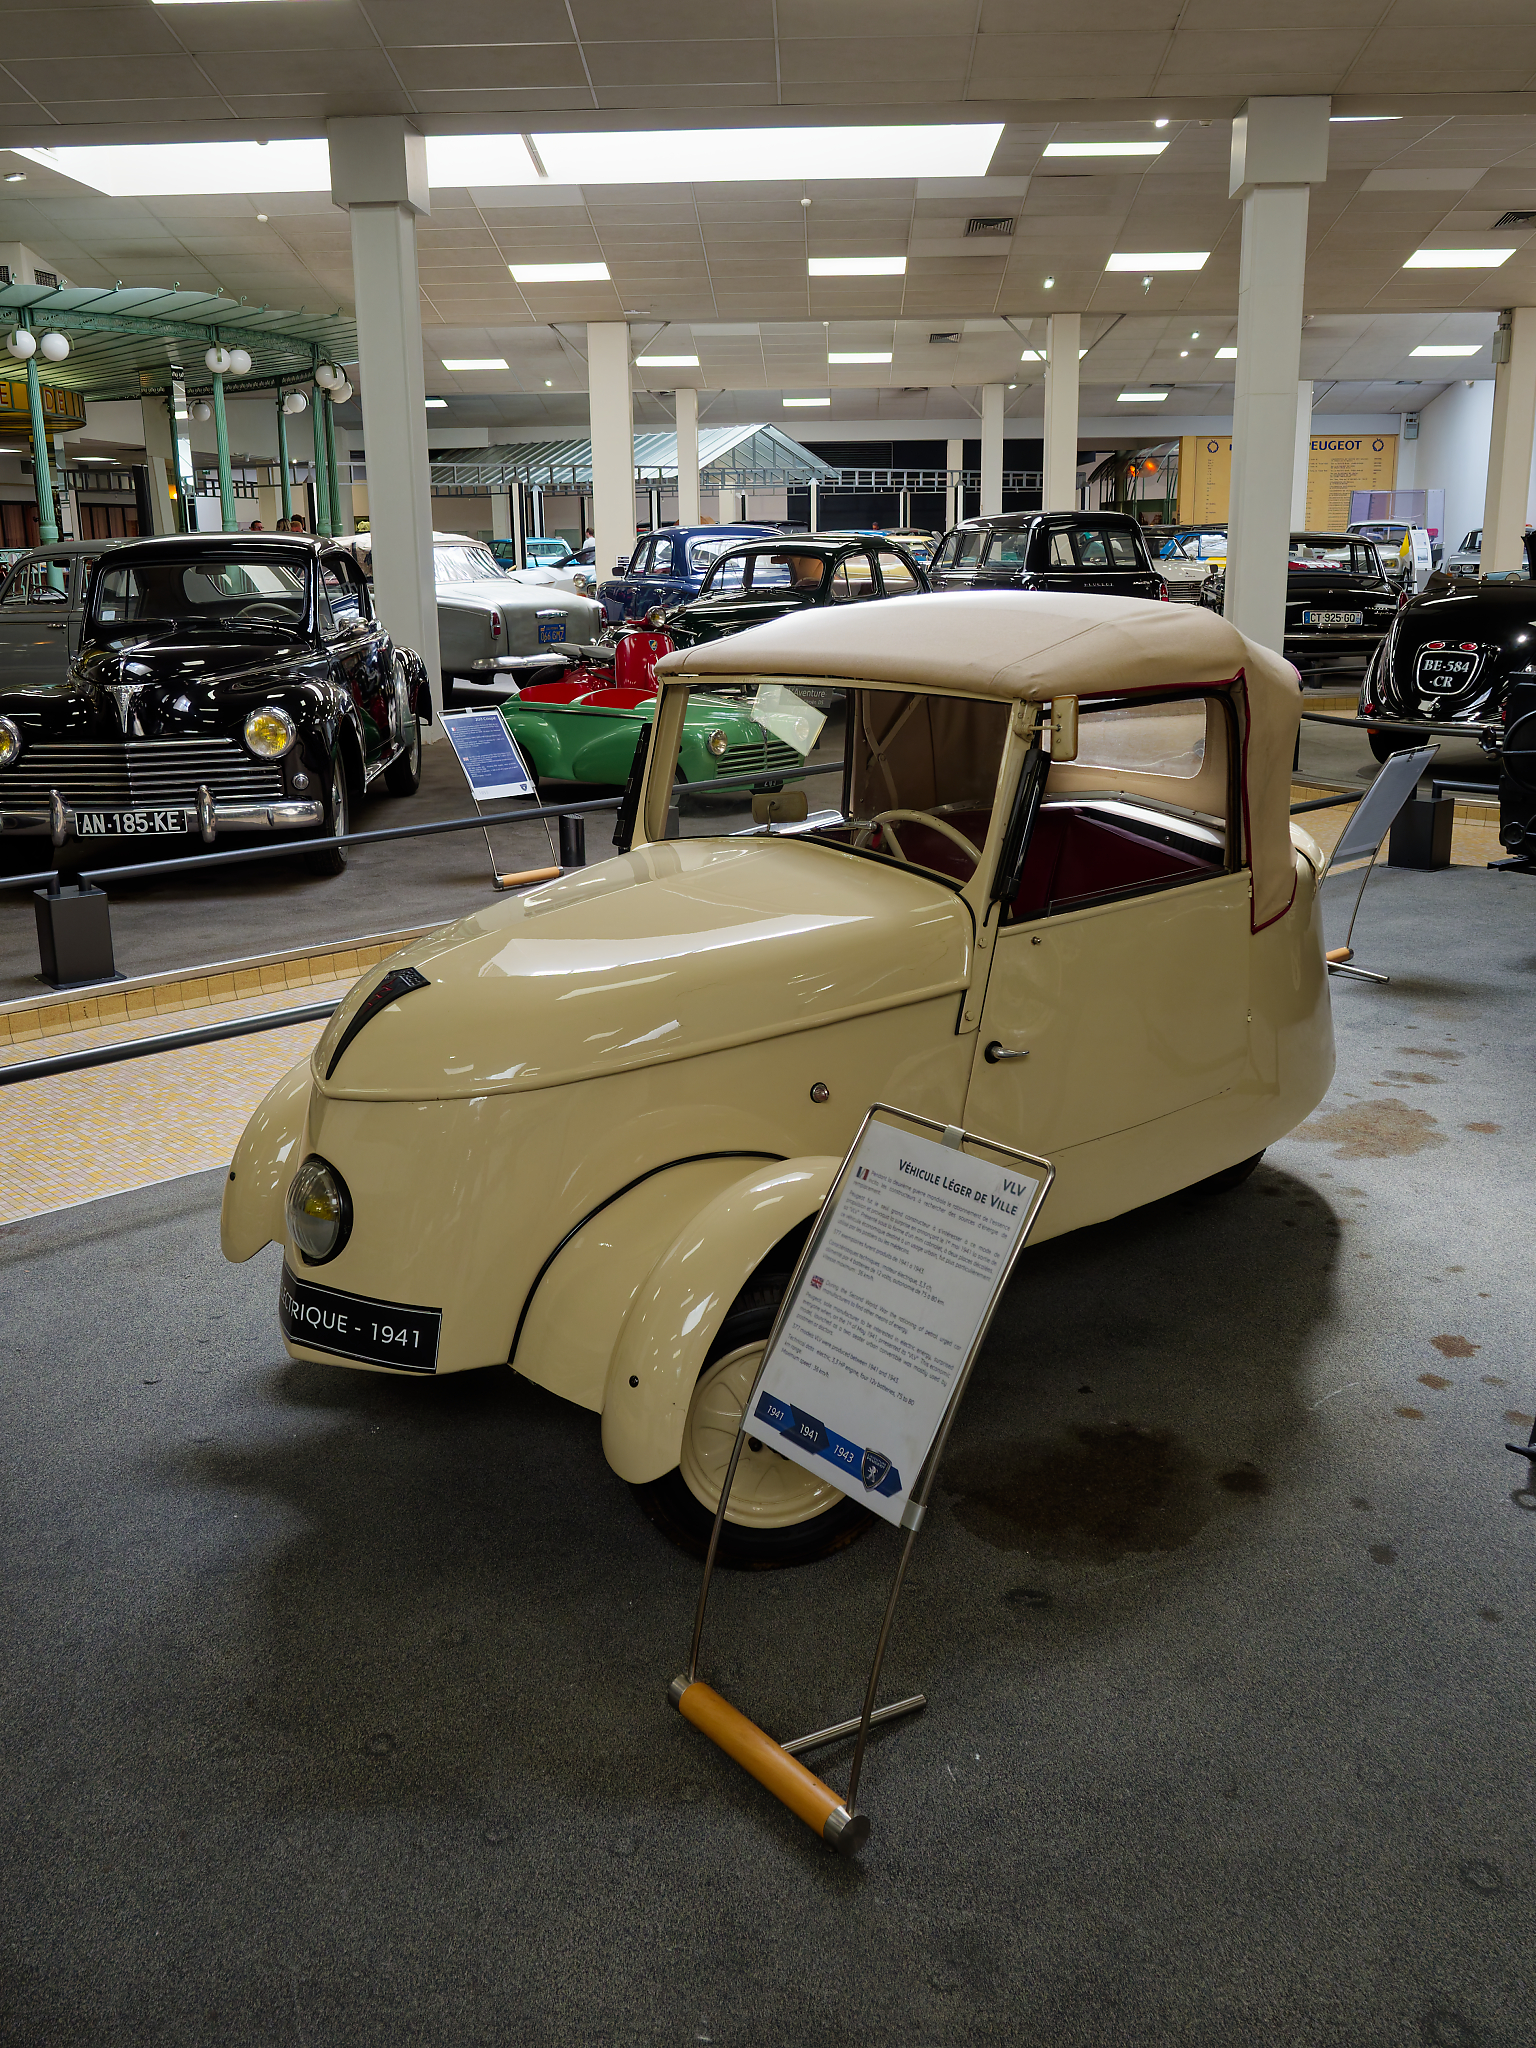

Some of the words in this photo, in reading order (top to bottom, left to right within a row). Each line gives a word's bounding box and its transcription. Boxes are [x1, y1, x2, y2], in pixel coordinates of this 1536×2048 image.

[44, 389, 65, 413] DE
[1309, 440, 1362, 451] EUGEOT
[1421, 659, 1470, 673] BE-584
[898, 1159, 941, 1186] VÉHICULE
[942, 1176, 973, 1198] LÉGER
[974, 1190, 987, 1204] DE
[989, 1194, 1019, 1216] VILLE
[1002, 1178, 1027, 1197] VLV
[371, 1322, 420, 1349] 1941
[766, 1404, 785, 1421] 1941
[799, 1423, 818, 1442] 1941
[833, 1443, 855, 1463] 1943
